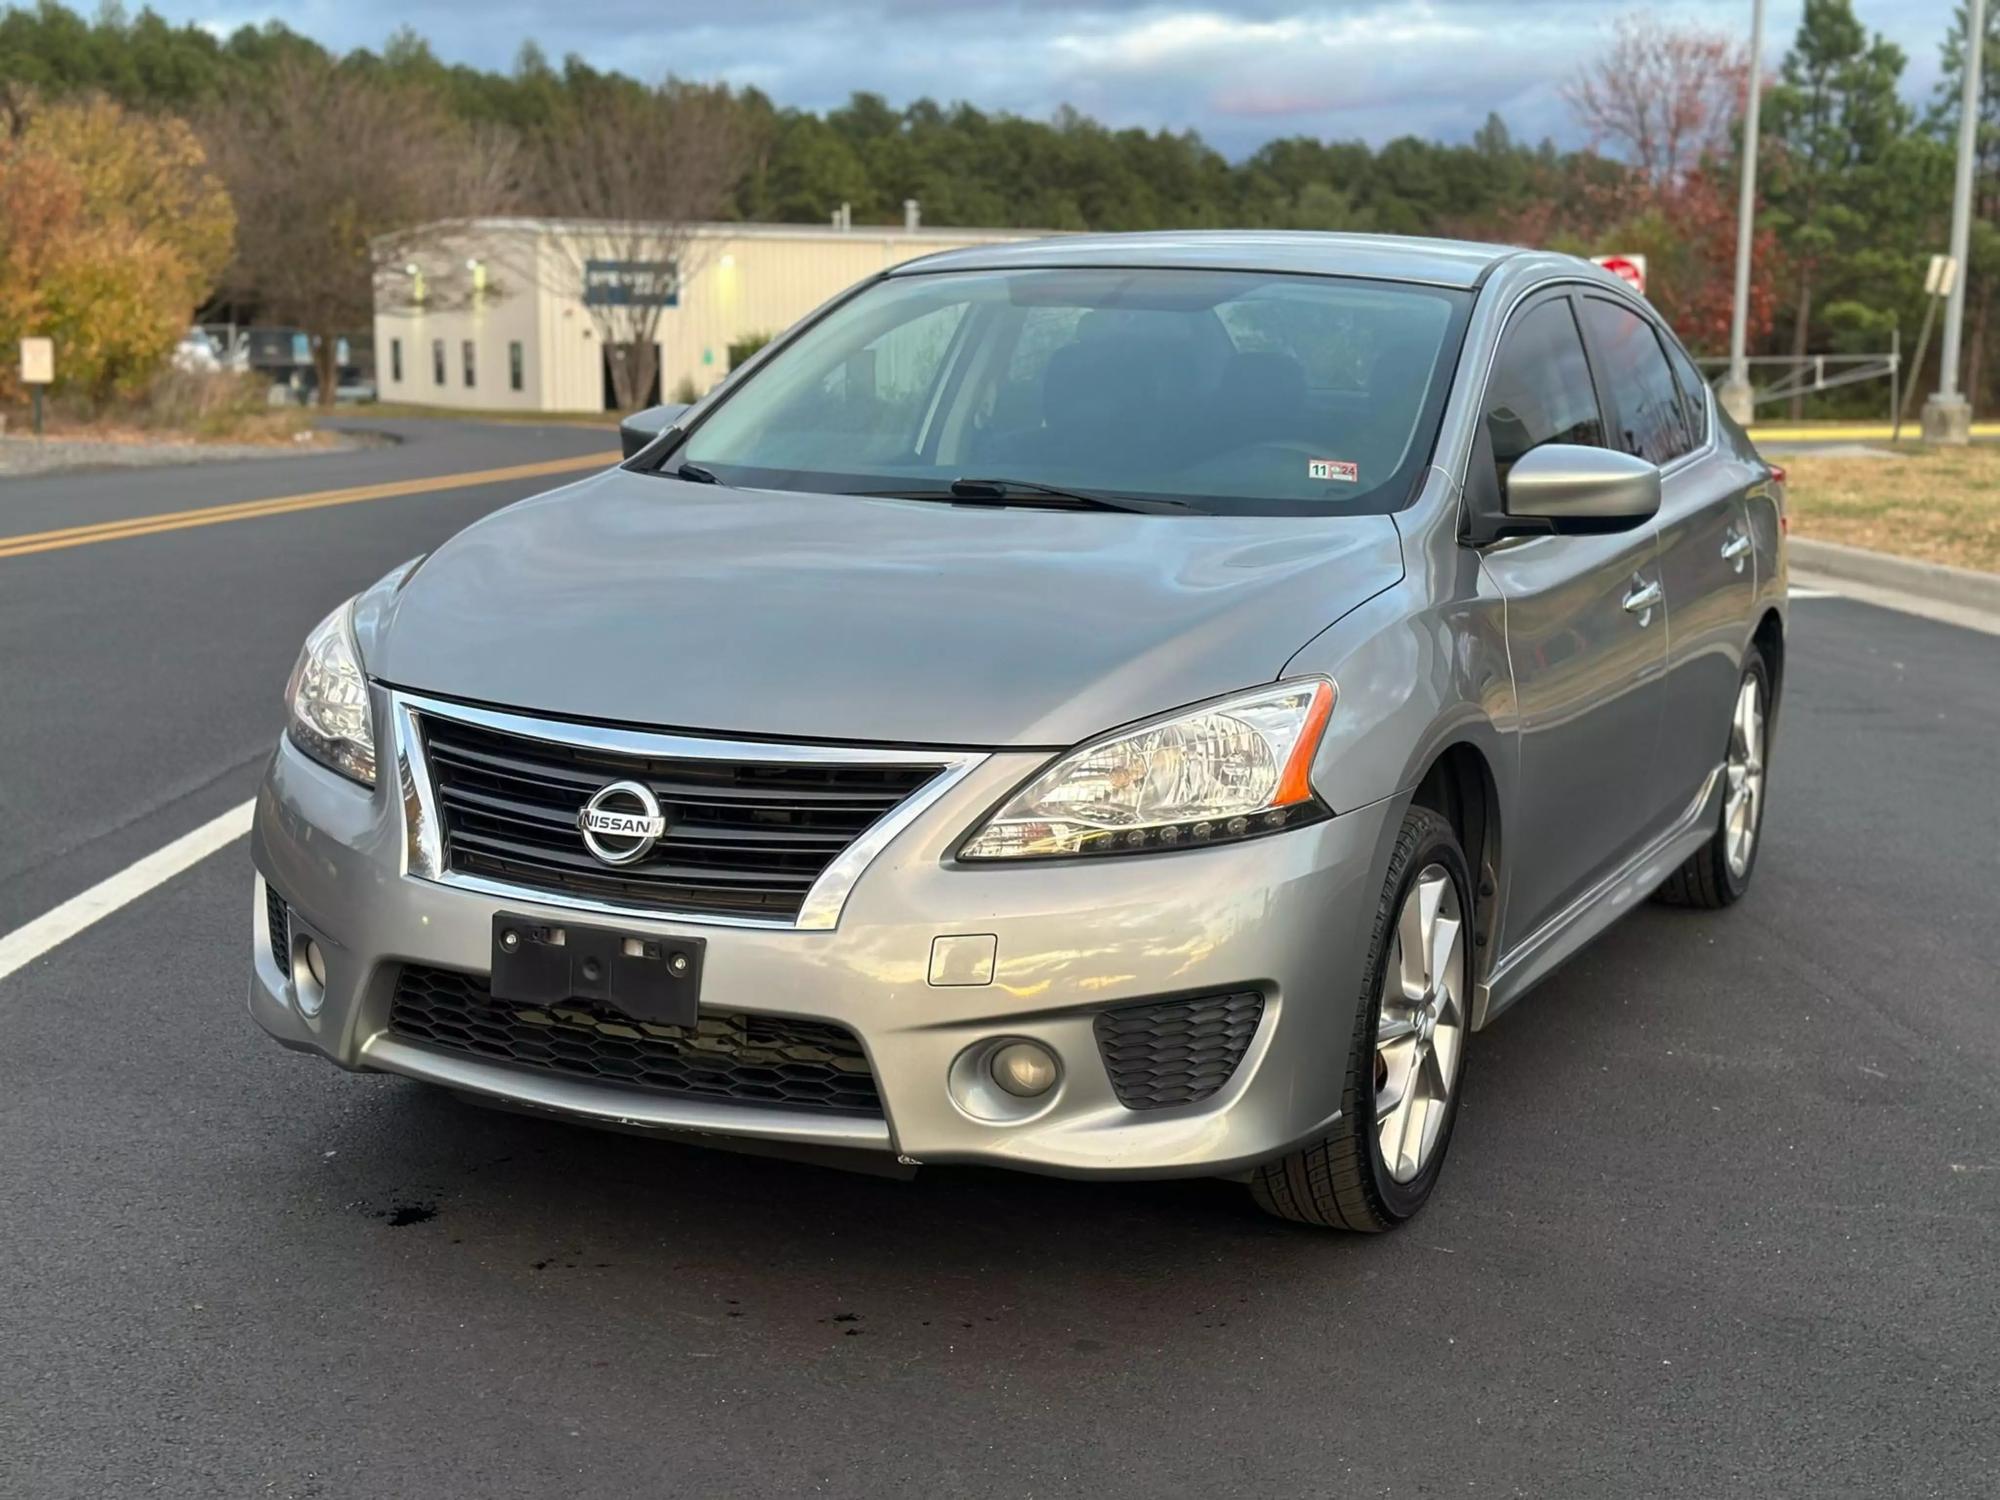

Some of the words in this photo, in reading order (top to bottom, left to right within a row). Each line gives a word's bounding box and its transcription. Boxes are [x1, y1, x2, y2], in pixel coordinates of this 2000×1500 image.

[1312, 464, 1327, 476] 11
[1341, 466, 1355, 475] 24
[582, 812, 651, 833] NISSAN
